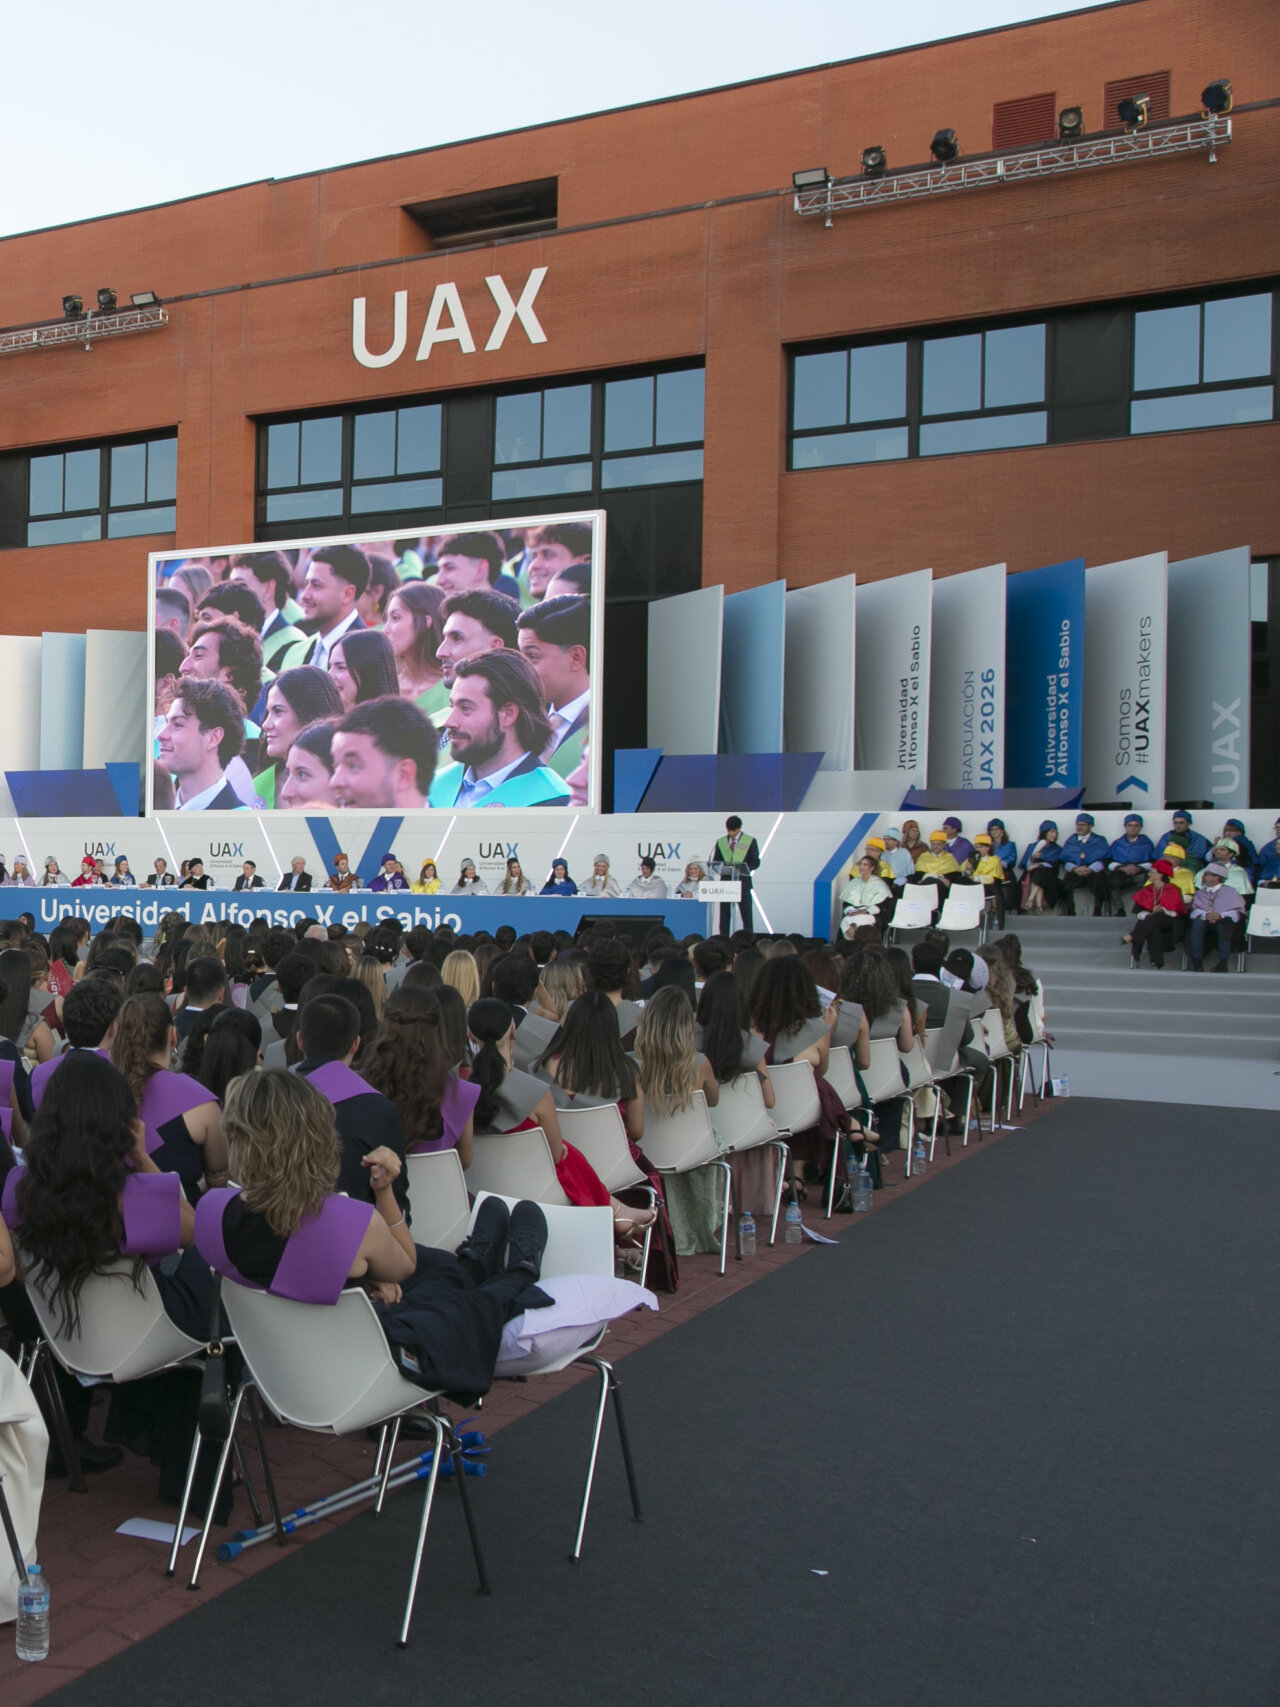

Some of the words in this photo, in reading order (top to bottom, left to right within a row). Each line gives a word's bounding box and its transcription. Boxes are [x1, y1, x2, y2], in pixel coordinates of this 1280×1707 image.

[353, 266, 549, 369] UAX
[910, 625, 921, 672] Sabio
[1059, 619, 1071, 669] Sabio
[910, 676, 919, 691] el
[1058, 692, 1069, 705] X
[1059, 672, 1070, 688] el
[1135, 615, 1152, 765] #UAXmakers
[910, 695, 919, 707] X
[980, 668, 995, 733] 2026
[1045, 674, 1057, 777] Universidad
[1057, 708, 1069, 775] Alfonso
[1116, 688, 1132, 766] Somos
[1212, 697, 1241, 794] UAX
[84, 842, 116, 856] UAX
[210, 842, 243, 857] UAX
[479, 842, 519, 858] UAX
[638, 842, 681, 859] UAX
[200, 902, 306, 929] Alfonso
[314, 904, 335, 923] X
[342, 905, 368, 931] el
[375, 905, 462, 934] Sabio
